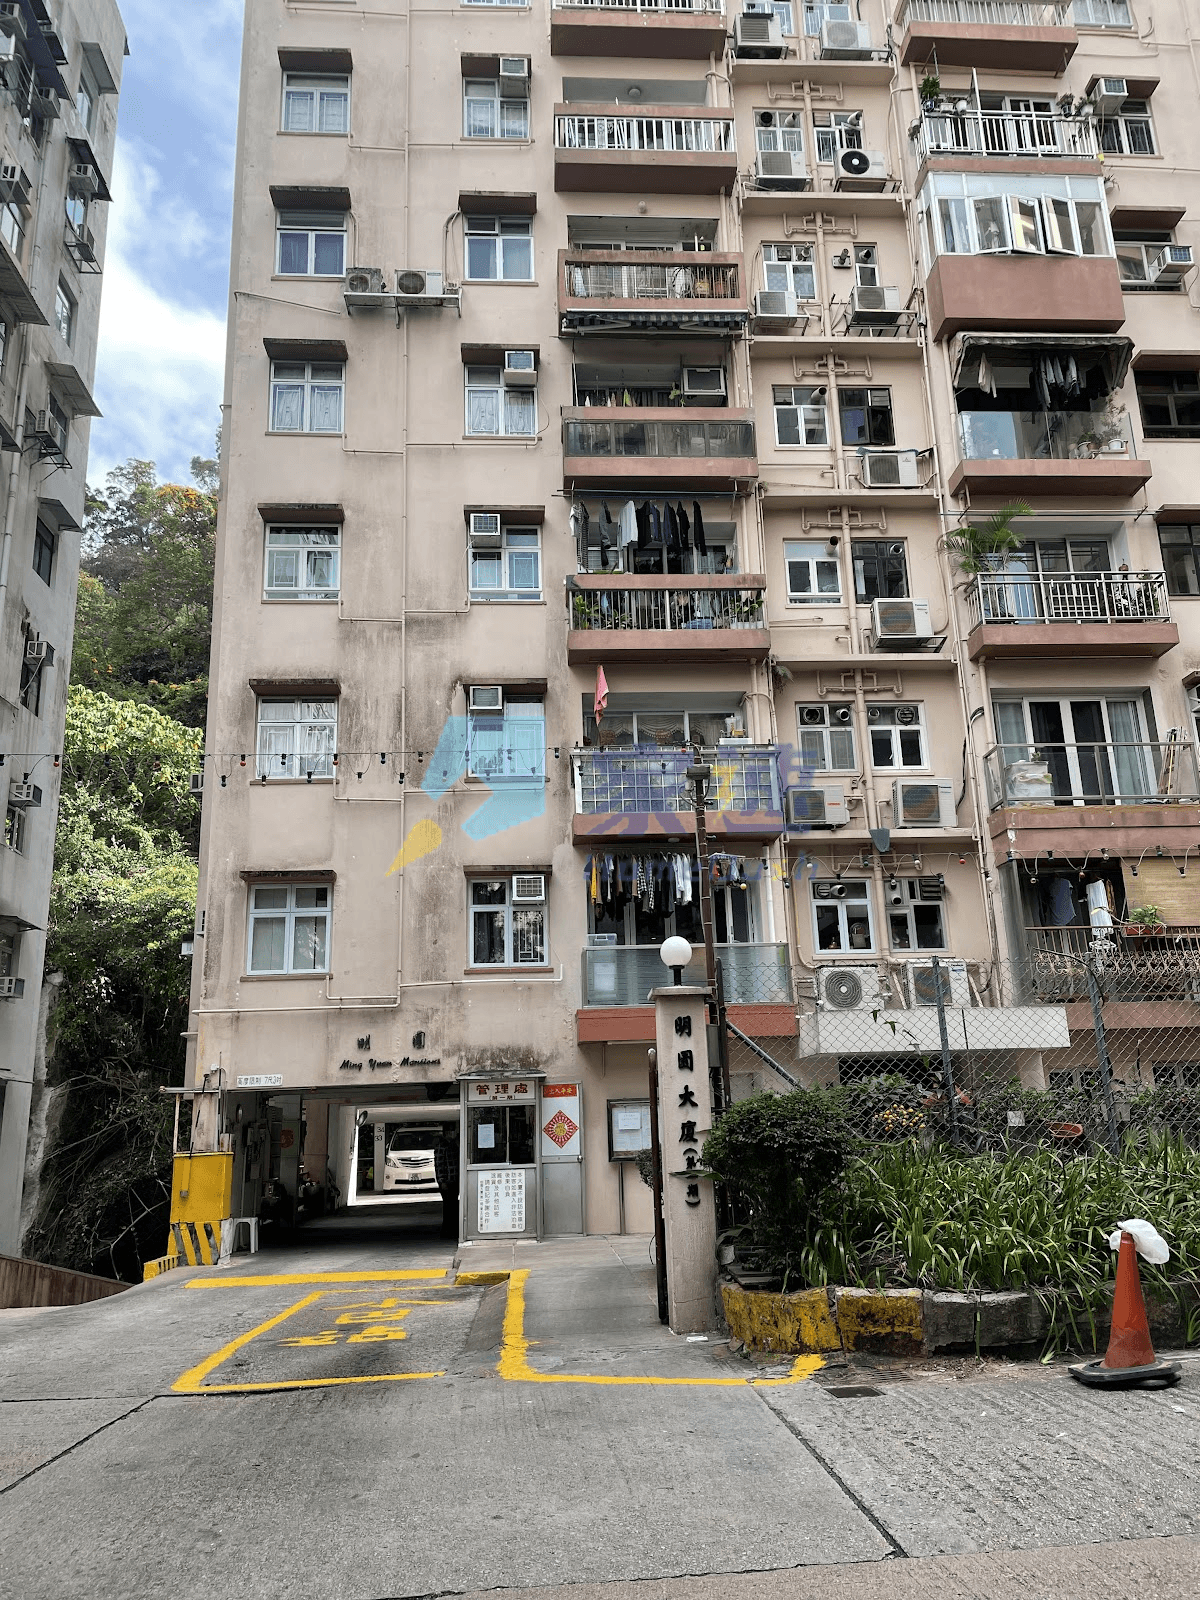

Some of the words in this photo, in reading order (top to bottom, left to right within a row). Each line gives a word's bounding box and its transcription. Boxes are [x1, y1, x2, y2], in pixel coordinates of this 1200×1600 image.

[340, 1060, 363, 1072] Ming
[369, 1059, 392, 1071] Yuan
[476, 1082, 528, 1096] 管理處
